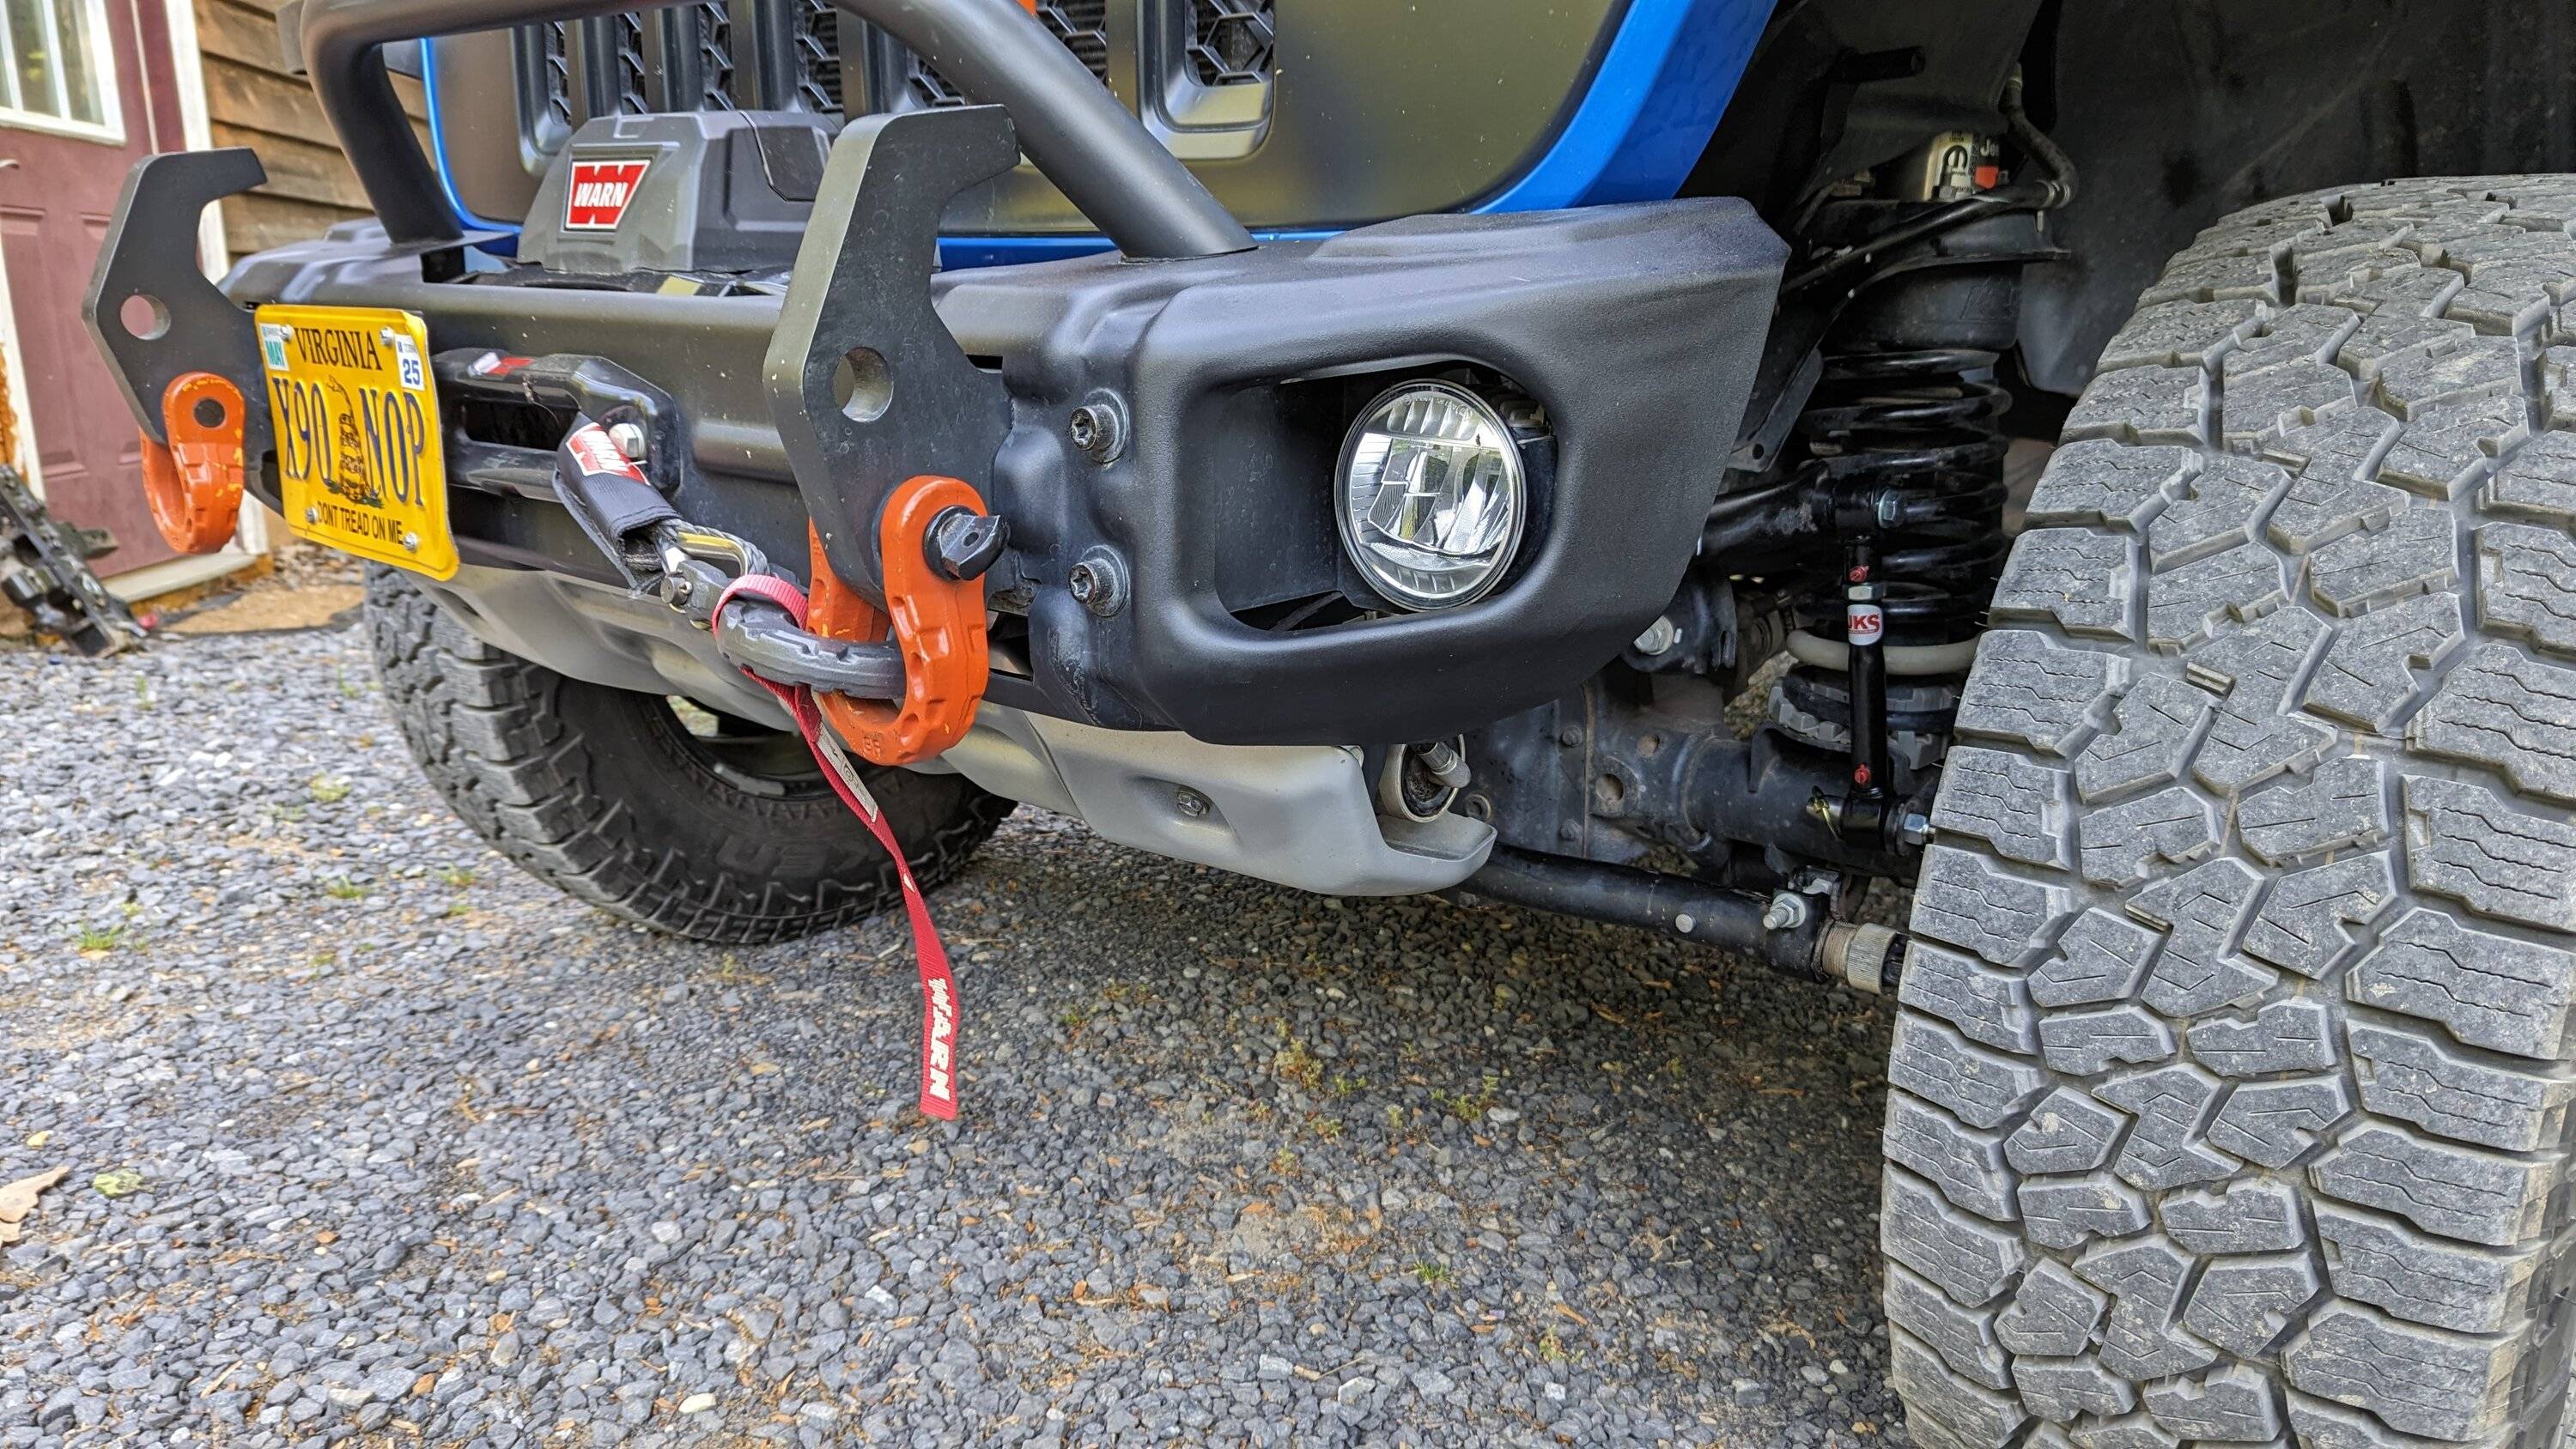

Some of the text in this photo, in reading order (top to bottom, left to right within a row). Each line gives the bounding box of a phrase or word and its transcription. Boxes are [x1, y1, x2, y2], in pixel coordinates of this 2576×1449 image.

[574, 182, 629, 208] WARN
[265, 341, 284, 367] MAY
[293, 327, 383, 371] VIRGINIA
[402, 358, 421, 385] 25
[358, 387, 425, 507] NOP
[339, 506, 370, 537] TREAD
[371, 515, 386, 541] ON
[387, 518, 404, 545] ME
[928, 978, 953, 1100] WARN
